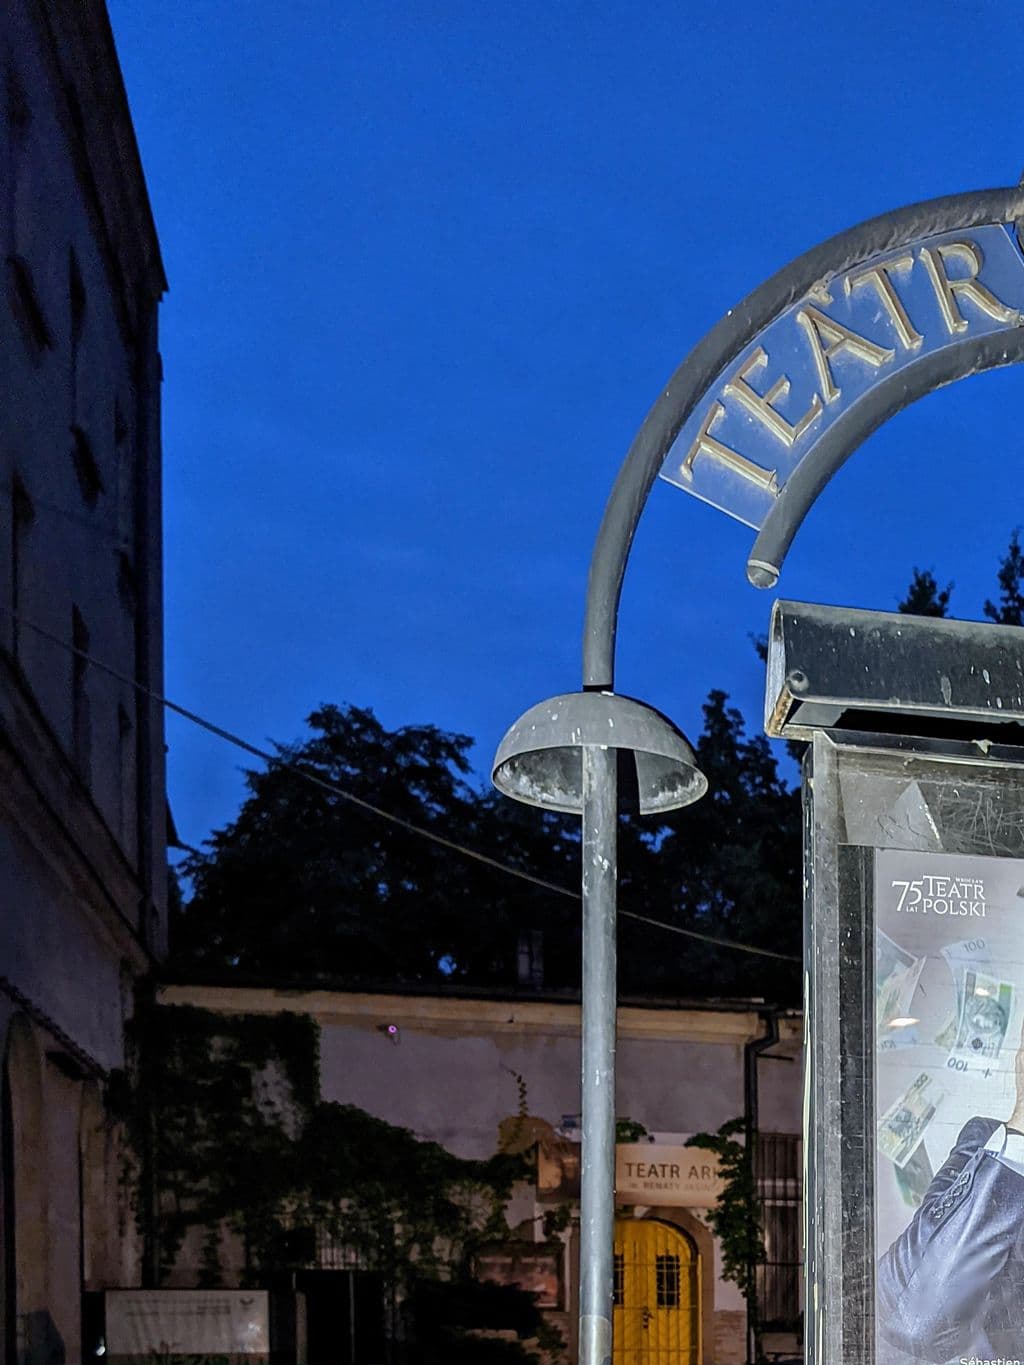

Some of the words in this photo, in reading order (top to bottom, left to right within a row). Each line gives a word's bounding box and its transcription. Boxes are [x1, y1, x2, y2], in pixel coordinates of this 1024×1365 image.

[891, 880, 923, 912] 75
[922, 875, 986, 900] TEATR
[922, 898, 986, 917] POLSKI
[964, 938, 985, 952] 100
[625, 1162, 681, 1179] TEATR
